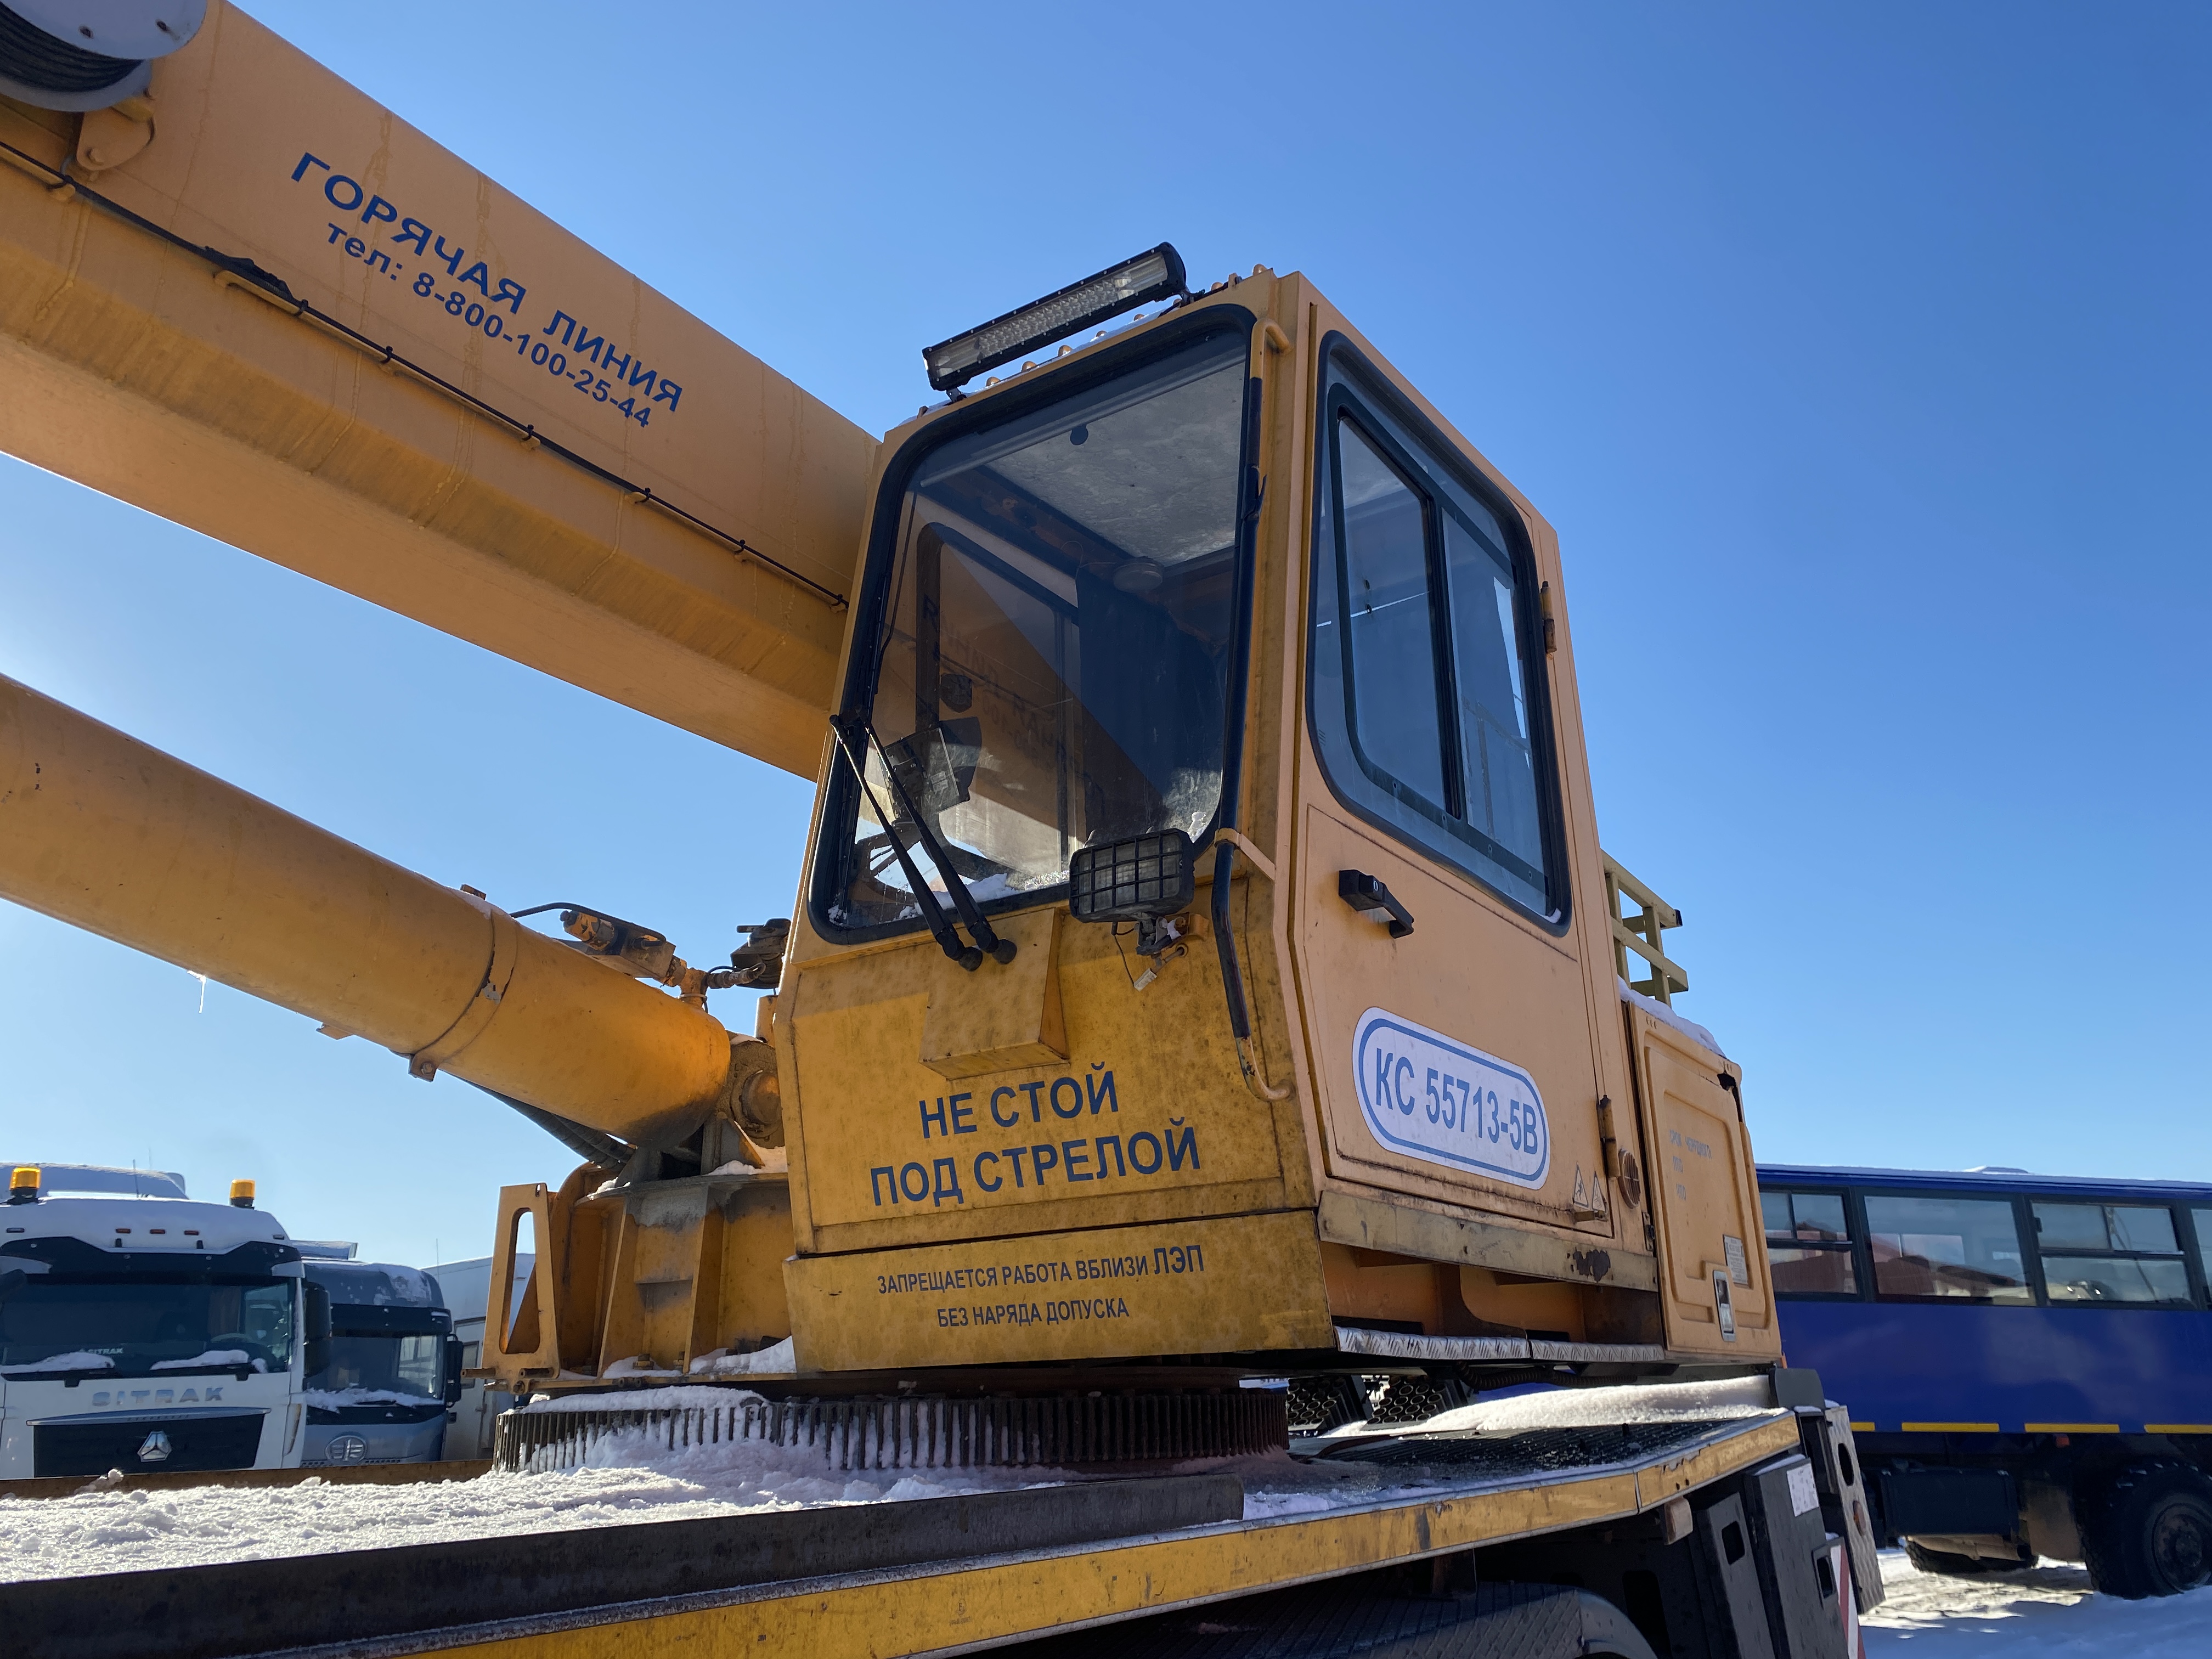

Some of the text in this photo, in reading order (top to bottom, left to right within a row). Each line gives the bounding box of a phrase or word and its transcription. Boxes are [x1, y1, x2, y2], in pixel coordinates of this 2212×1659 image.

[291, 152, 683, 413] ГОРЯЧАЯ ЛИНИЯ
[328, 222, 651, 427] тел: 8-800-100-25-44
[919, 1061, 1119, 1139] НЕ СТОЙ
[1375, 1047, 1539, 1155] КС 55713-5В
[871, 1116, 1200, 1206] ПОД СТРЕЛОЙ
[877, 1244, 1205, 1295] ЗАПРЕЩАЕТСЯ РАБОТА ВБЛИЗИ ЛЭП
[938, 1297, 1129, 1328] БЕЗ НАРЯДА ДОПУСКА
[92, 1386, 224, 1407] SITRAK
